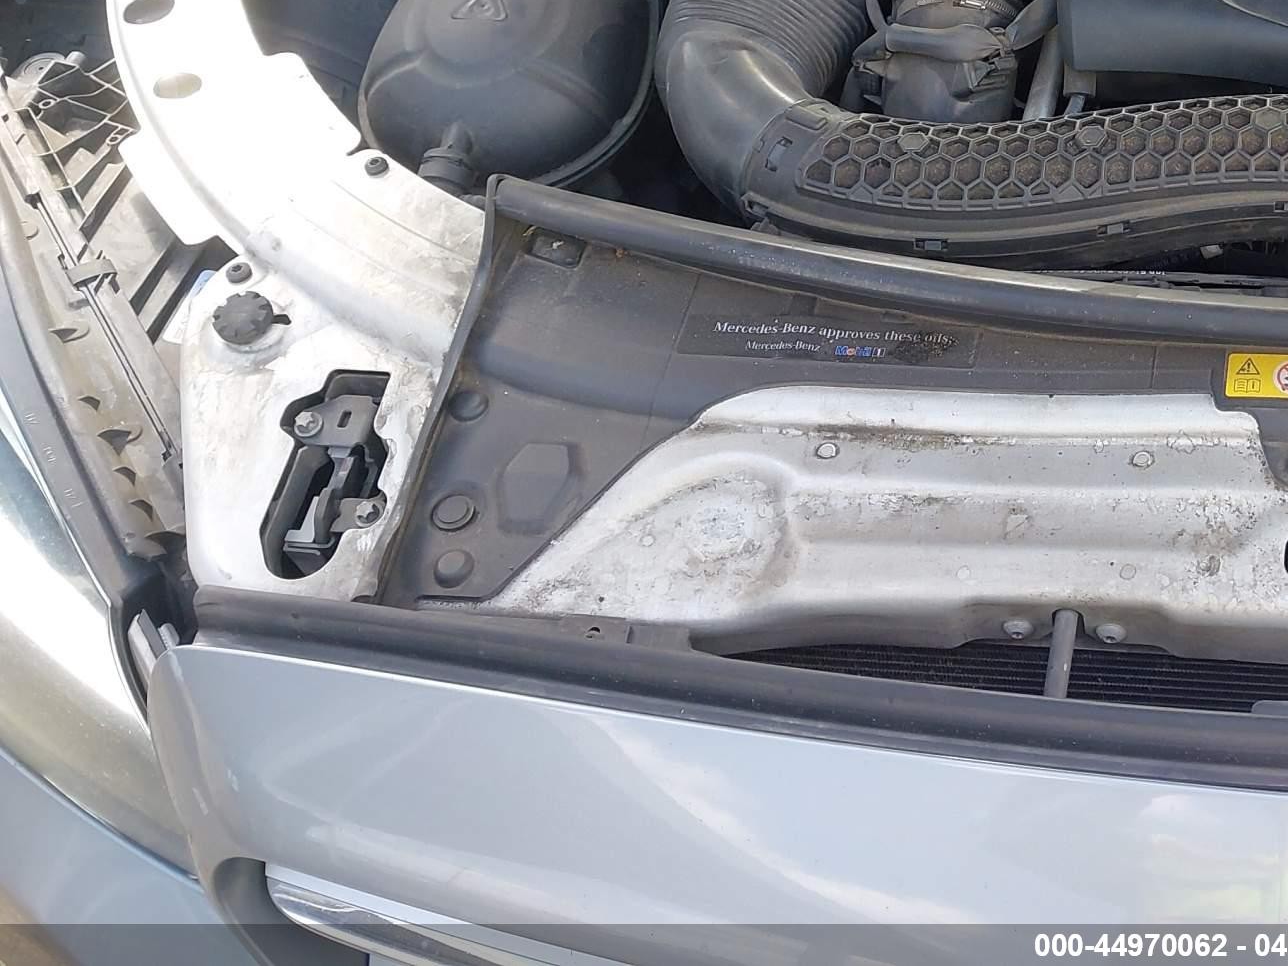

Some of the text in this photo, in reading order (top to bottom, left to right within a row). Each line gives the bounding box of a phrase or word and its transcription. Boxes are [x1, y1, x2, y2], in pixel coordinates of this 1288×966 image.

[713, 322, 816, 334] Mercedes-Benz
[819, 327, 881, 340] approves
[885, 331, 920, 341] these
[745, 340, 821, 352] Mercedes-Benz
